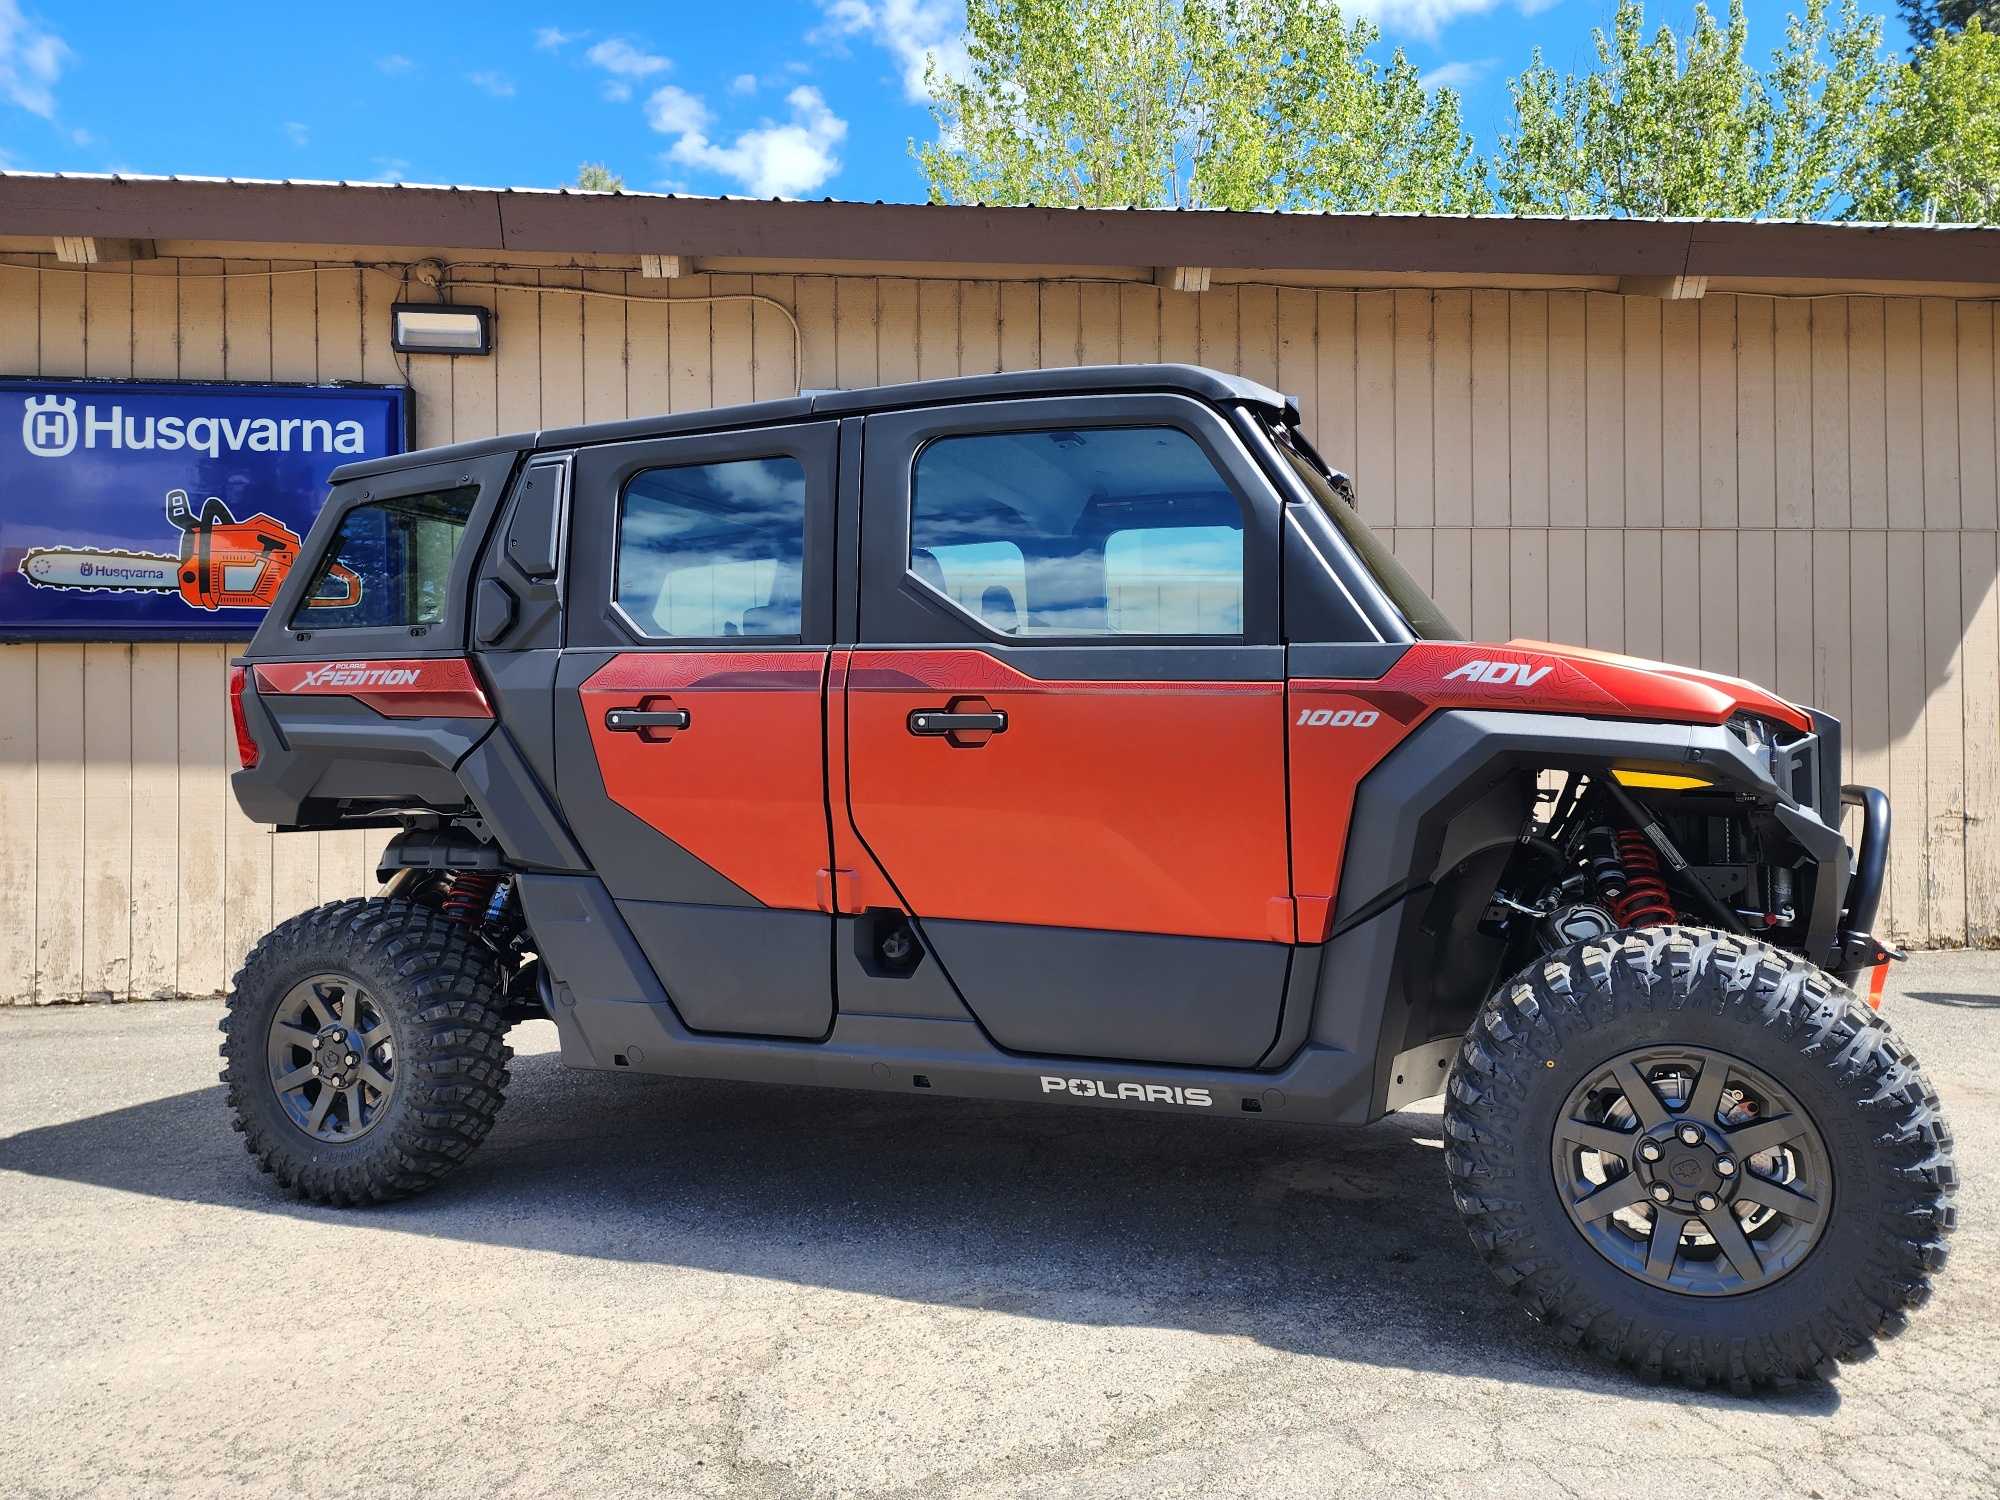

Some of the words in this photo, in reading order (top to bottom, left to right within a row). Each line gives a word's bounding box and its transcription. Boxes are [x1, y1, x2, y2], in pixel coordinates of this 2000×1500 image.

[85, 405, 365, 458] Husqvarna
[95, 565, 164, 580] Husqvarna
[291, 664, 421, 691] XPEDITION
[1443, 660, 1554, 686] ADV
[1296, 709, 1380, 728] 1000
[1040, 1076, 1213, 1107] POLARIS
